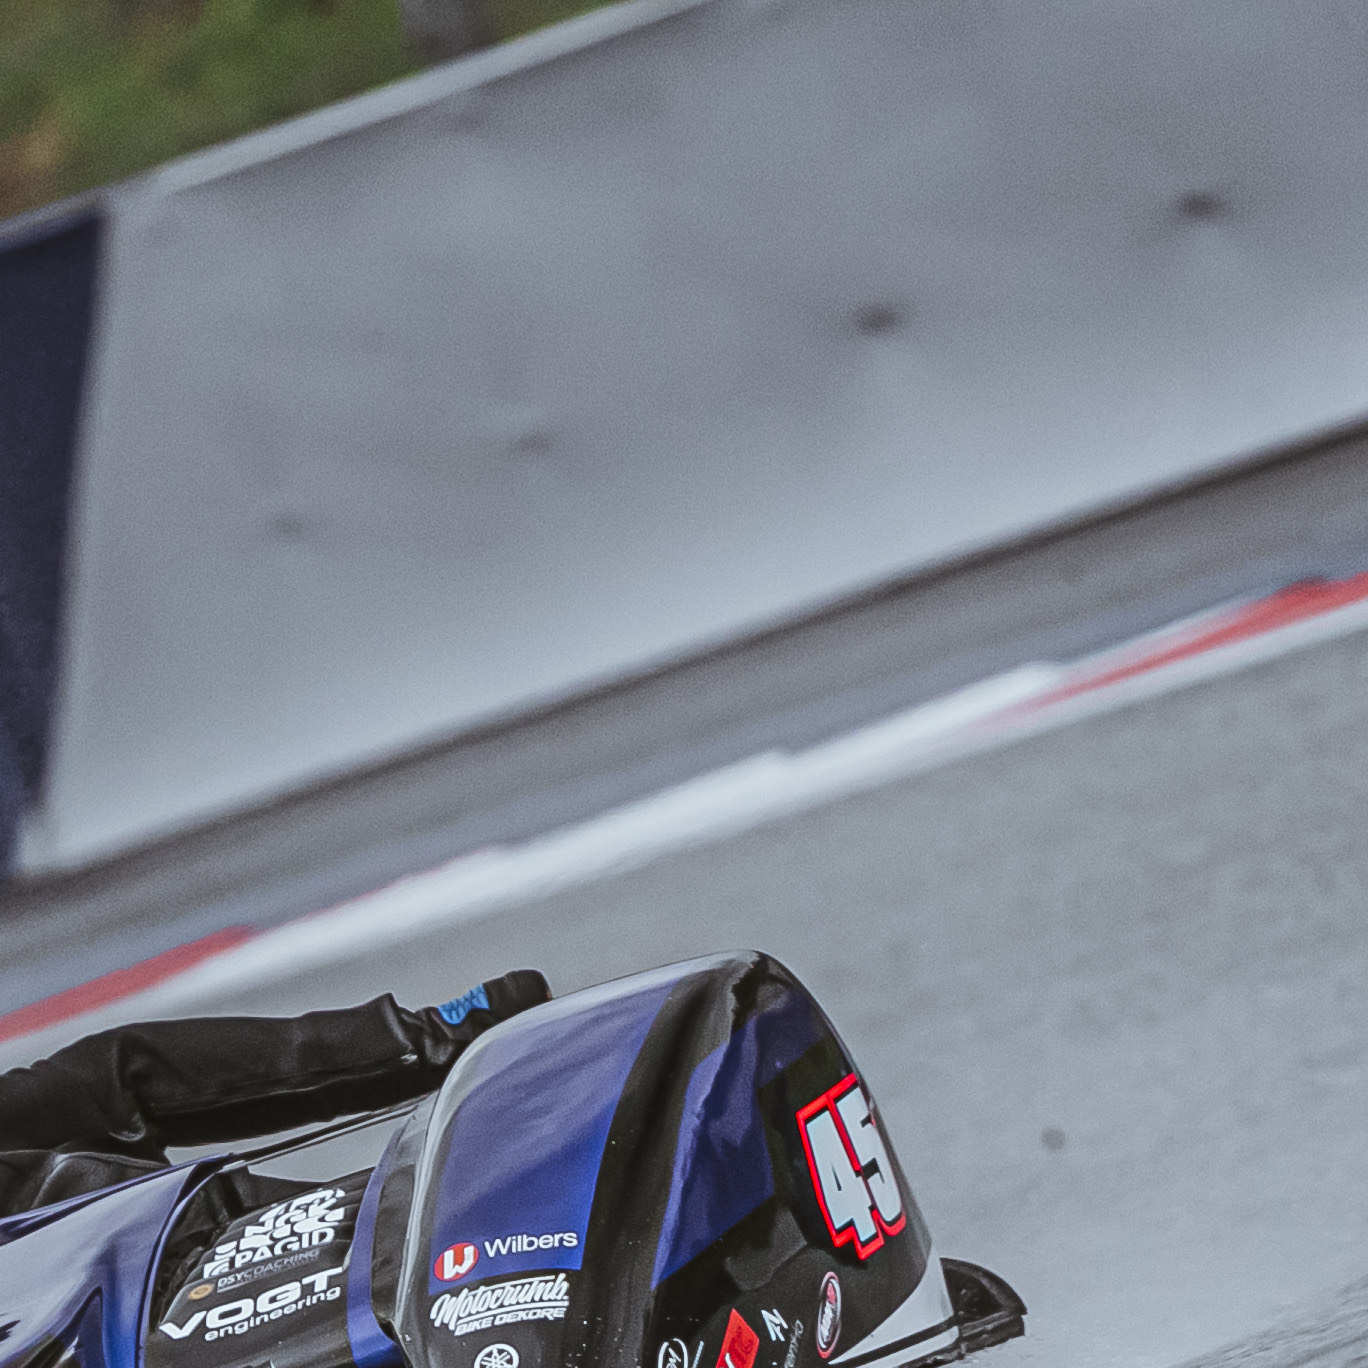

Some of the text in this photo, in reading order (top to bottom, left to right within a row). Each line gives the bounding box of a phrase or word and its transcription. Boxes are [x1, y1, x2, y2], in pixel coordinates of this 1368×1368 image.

[802, 1083, 905, 1248] 45
[234, 1228, 335, 1268] PAGID
[484, 1232, 578, 1257] Wilbers
[159, 1267, 343, 1339] VOGT
[205, 1286, 341, 1341] engineering
[454, 1316, 492, 1336] BIKE
